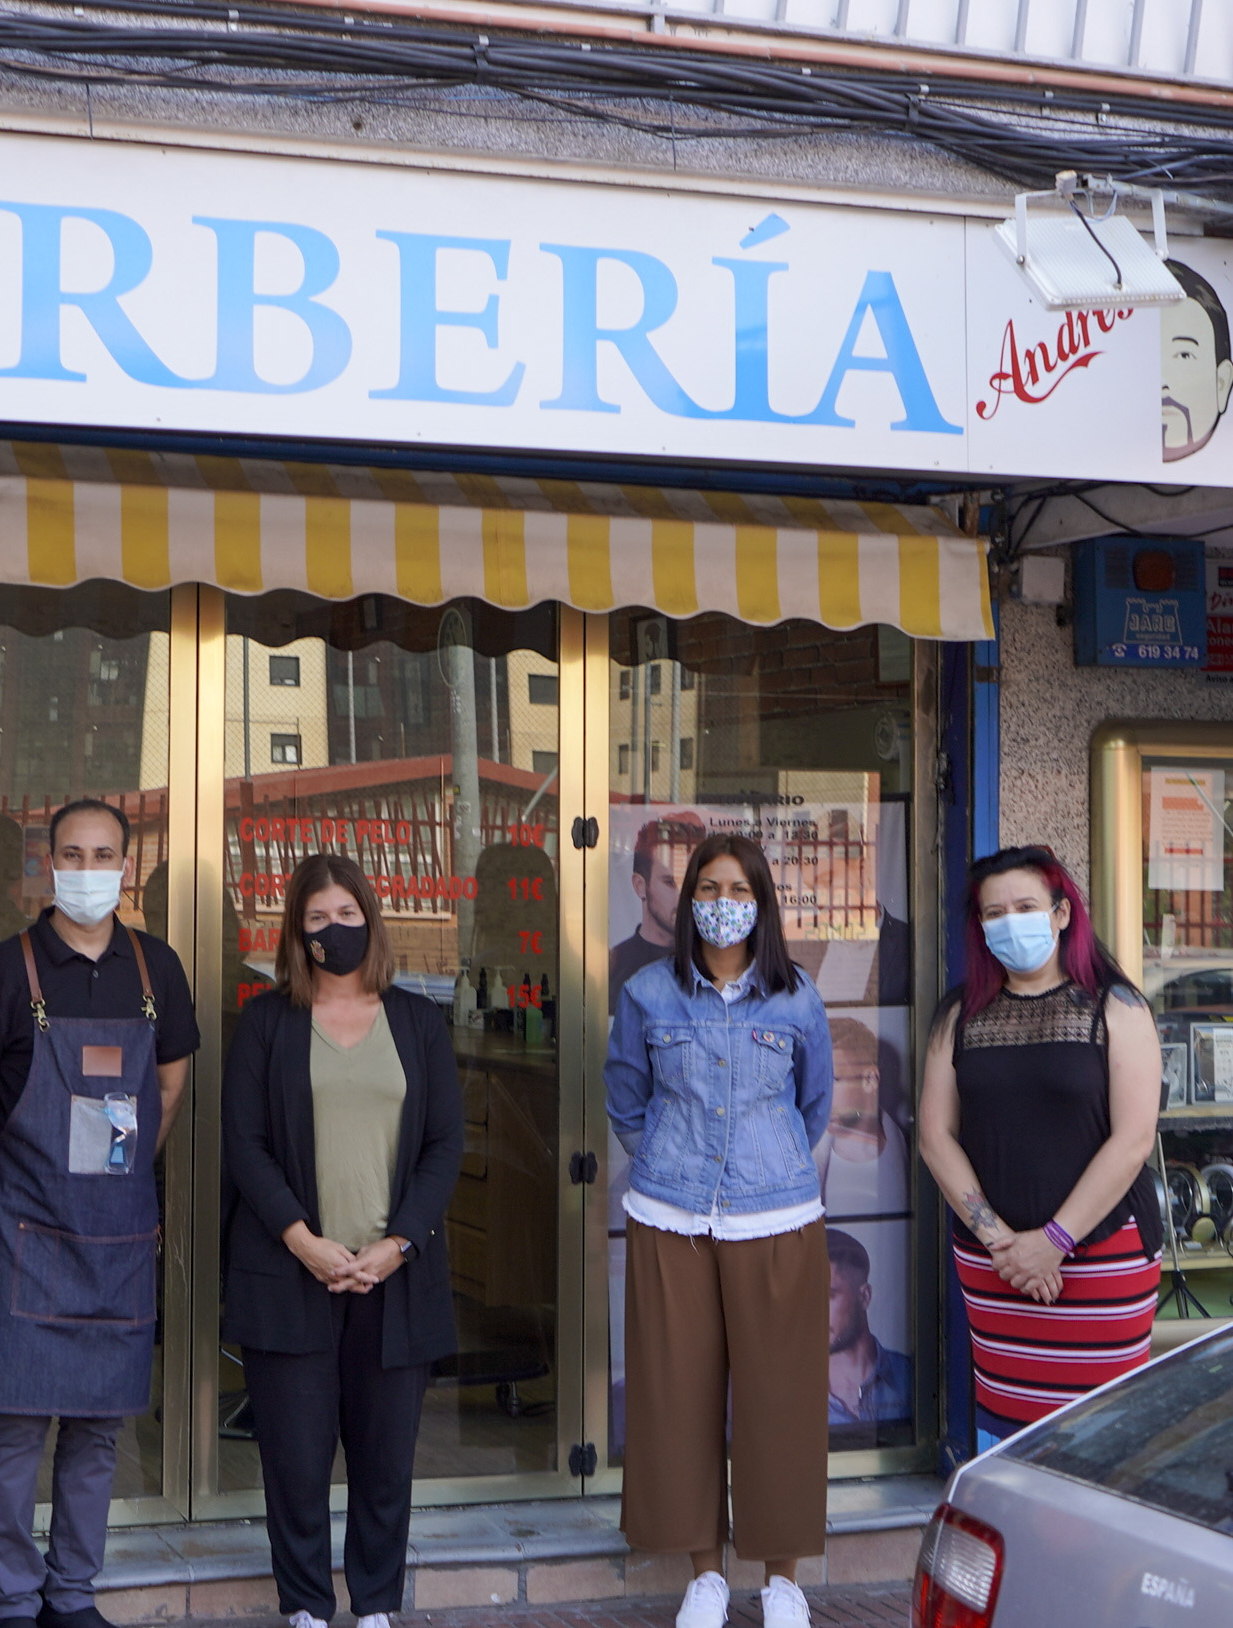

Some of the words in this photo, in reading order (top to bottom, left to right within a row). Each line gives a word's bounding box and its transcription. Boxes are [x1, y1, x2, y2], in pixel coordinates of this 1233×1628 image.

[1138, 644, 1161, 659] 619
[1164, 645, 1181, 660] 34
[1184, 646, 1200, 660] 74
[240, 816, 314, 843] CORTE
[320, 818, 349, 844] DE
[356, 819, 412, 846] PELO
[508, 823, 544, 848] 10€
[709, 816, 751, 827] Lunes
[766, 817, 817, 828] Viernes
[768, 832, 776, 840] a
[771, 858, 779, 866] a
[239, 871, 294, 897] COR
[366, 874, 479, 900] GRADADO
[507, 877, 544, 901] 11€
[783, 894, 818, 905] 16:00
[239, 927, 281, 953] BAR
[519, 930, 544, 955] 7€
[506, 984, 543, 1009] 15€
[1140, 1571, 1196, 1609] ESPAÑA
